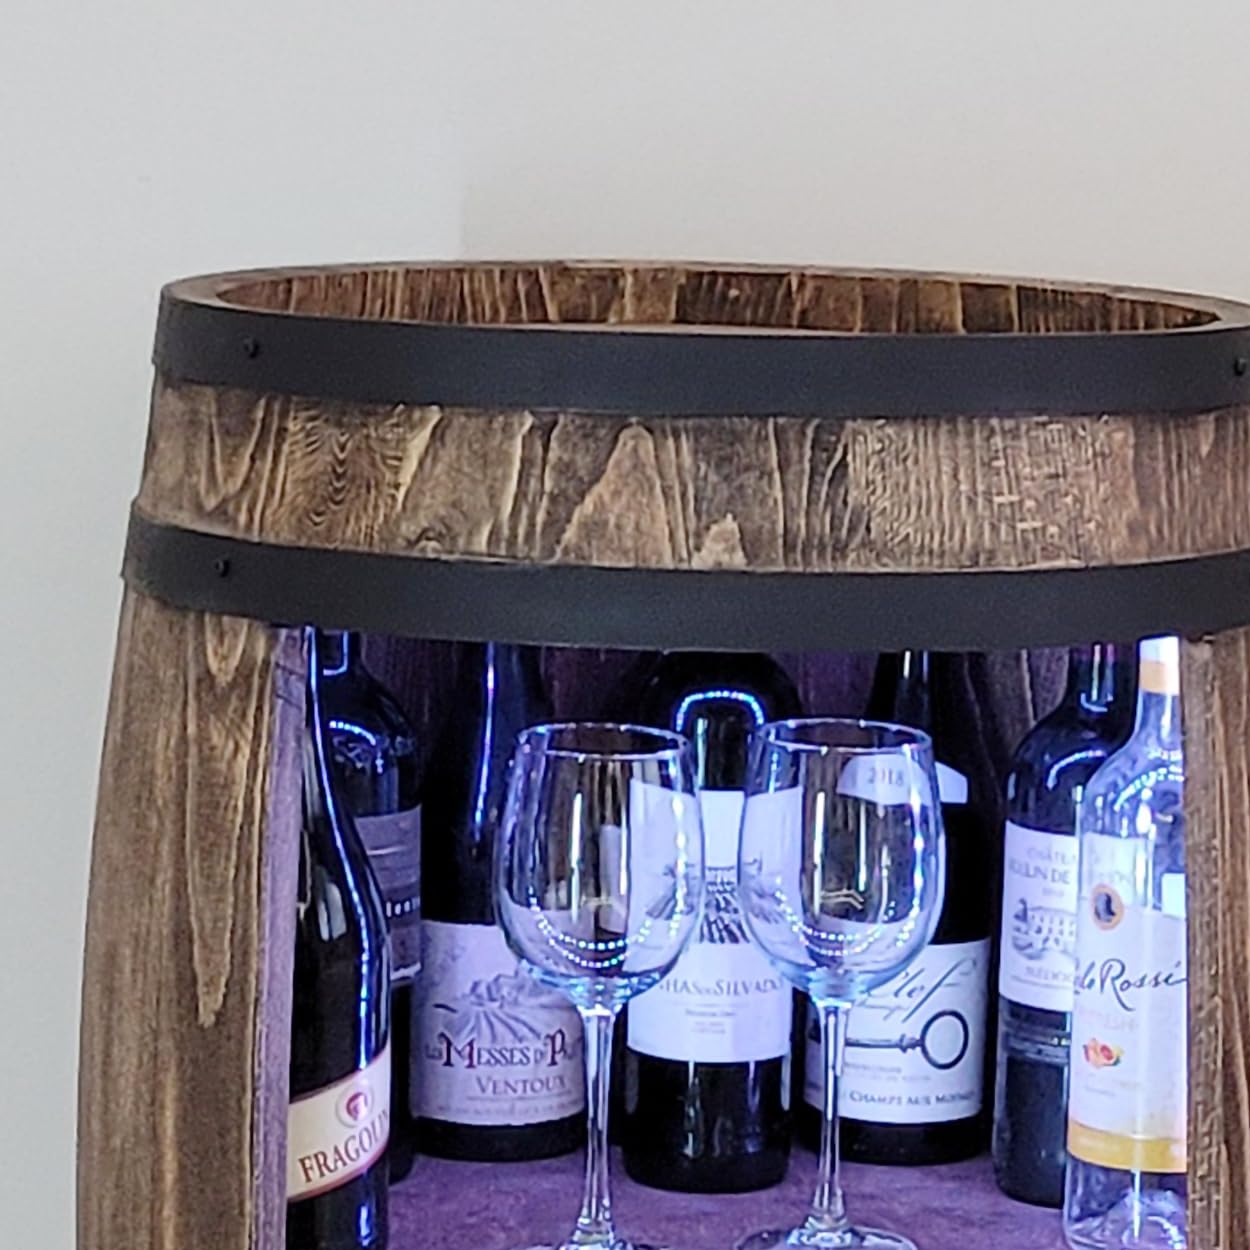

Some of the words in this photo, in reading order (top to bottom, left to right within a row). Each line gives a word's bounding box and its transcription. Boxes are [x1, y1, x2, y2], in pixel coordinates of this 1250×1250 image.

[1100, 958, 1187, 1011] Rossi
[439, 1032, 530, 1068] MESSES
[477, 1076, 566, 1096] VENTOUX
